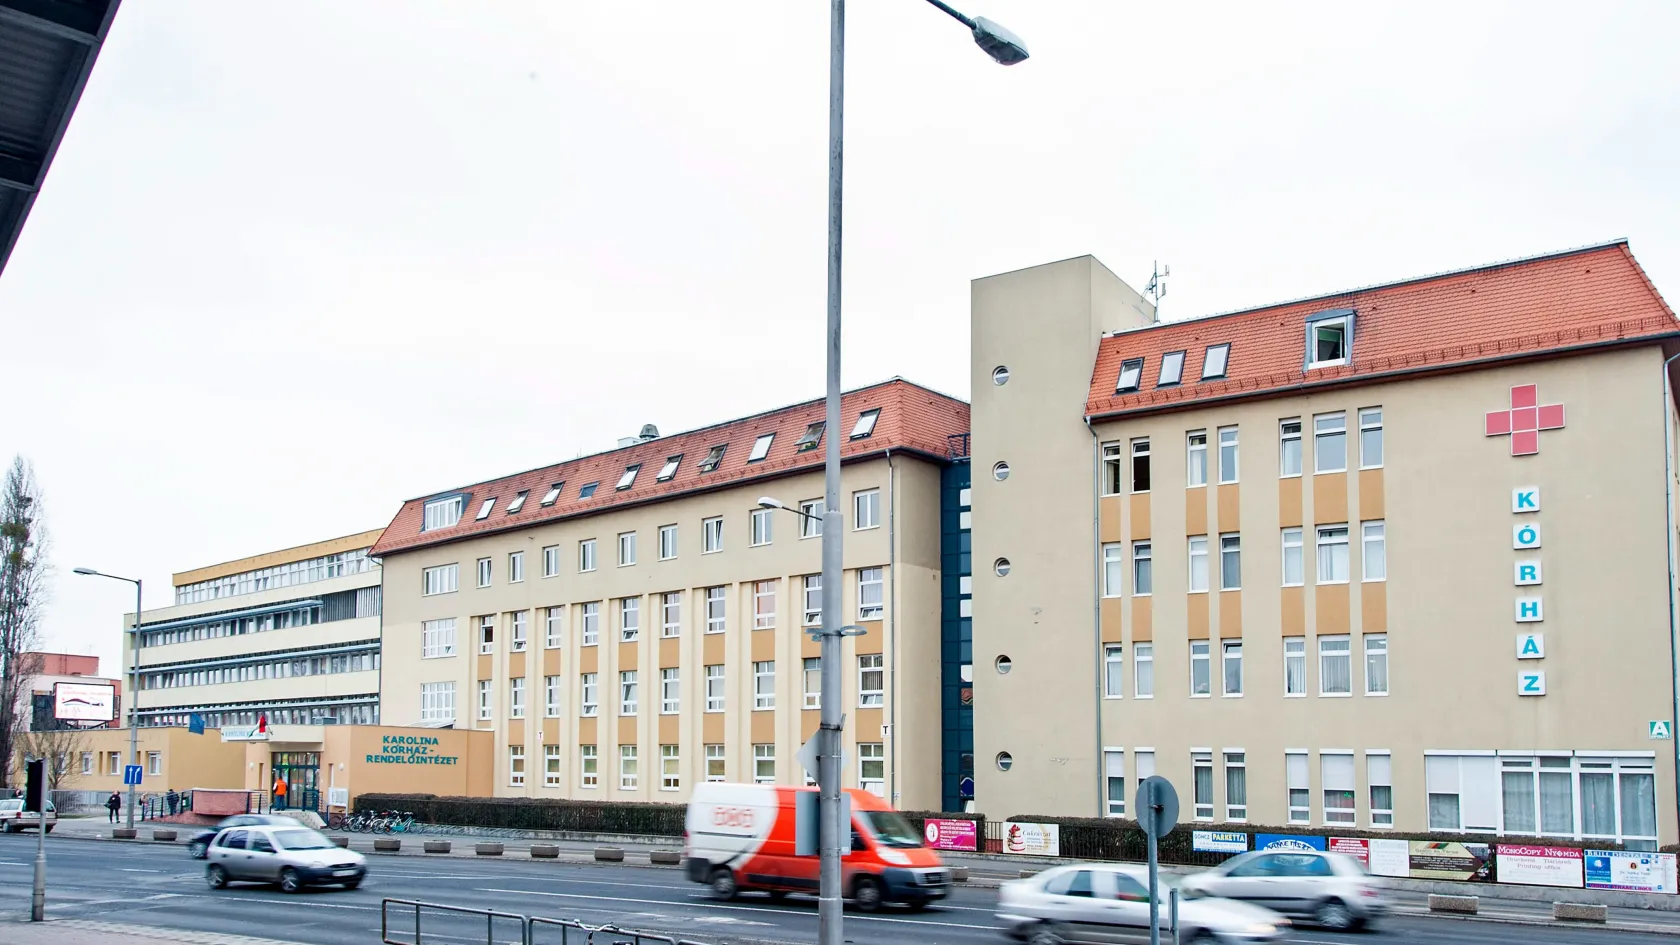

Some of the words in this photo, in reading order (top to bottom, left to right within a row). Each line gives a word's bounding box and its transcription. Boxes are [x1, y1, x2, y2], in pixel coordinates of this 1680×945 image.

[1517, 491, 1540, 691] KÓRHÁZ
[882, 725, 889, 735] T
[1651, 720, 1669, 736] A
[382, 735, 439, 745] KAROLINA
[1212, 833, 1245, 842] PARKETTA
